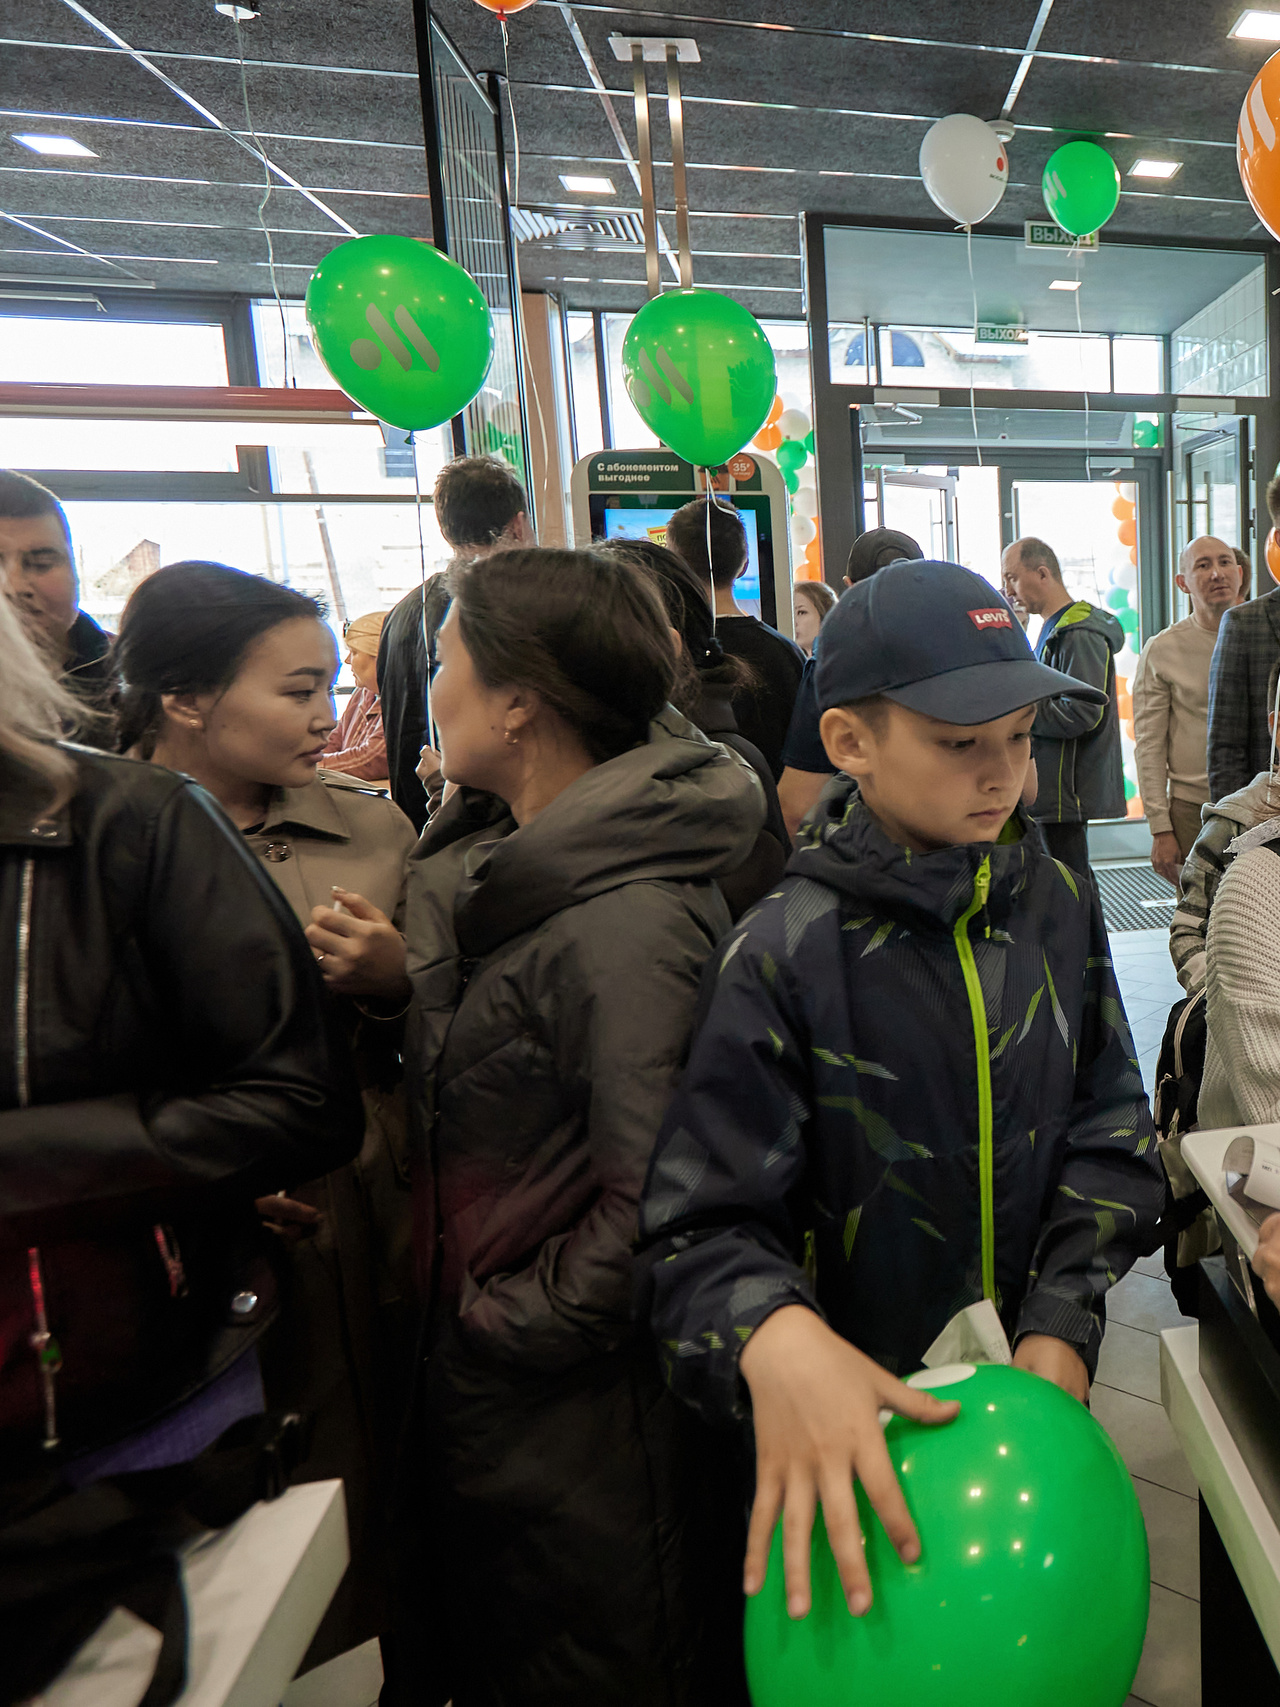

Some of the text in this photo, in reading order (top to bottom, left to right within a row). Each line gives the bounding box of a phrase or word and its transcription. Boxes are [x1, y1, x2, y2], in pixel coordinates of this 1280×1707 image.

[597, 462, 679, 472] С абонементом
[598, 474, 651, 484] выгоднее
